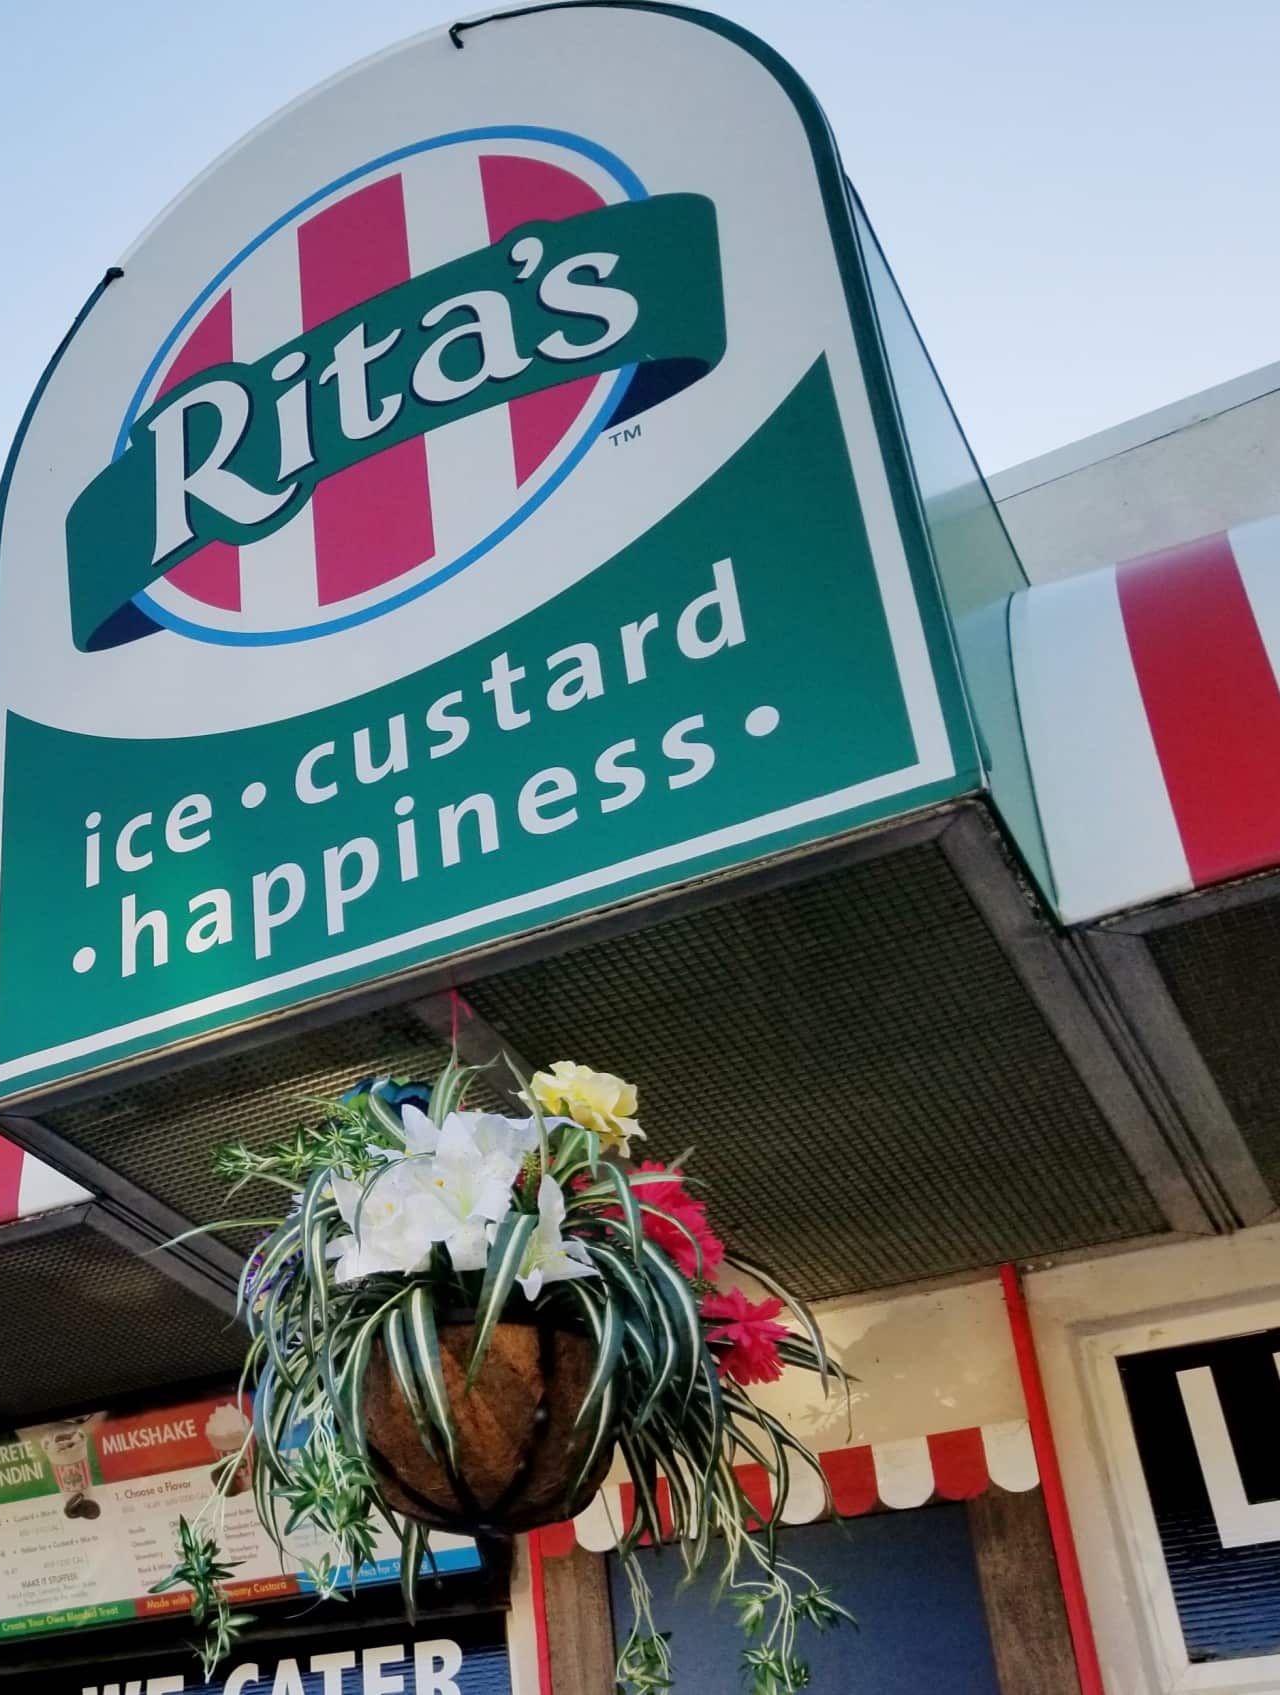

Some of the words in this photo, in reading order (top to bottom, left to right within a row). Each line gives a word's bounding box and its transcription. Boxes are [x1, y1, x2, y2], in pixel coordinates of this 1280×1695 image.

[148, 236, 639, 566] Rita's
[608, 424, 641, 447] TM
[85, 793, 212, 888] ice
[295, 558, 747, 804] custard
[121, 714, 715, 978] happiness
[102, 1419, 198, 1455] MILKSHAKE
[124, 1487, 156, 1499] Choose
[164, 1480, 192, 1491] Flavor
[146, 1597, 170, 1609] Made
[253, 1581, 287, 1593] Custard
[1, 1621, 28, 1632] Create
[28, 1617, 45, 1627] Your
[46, 1614, 66, 1625] Own
[98, 1605, 120, 1617] Treat
